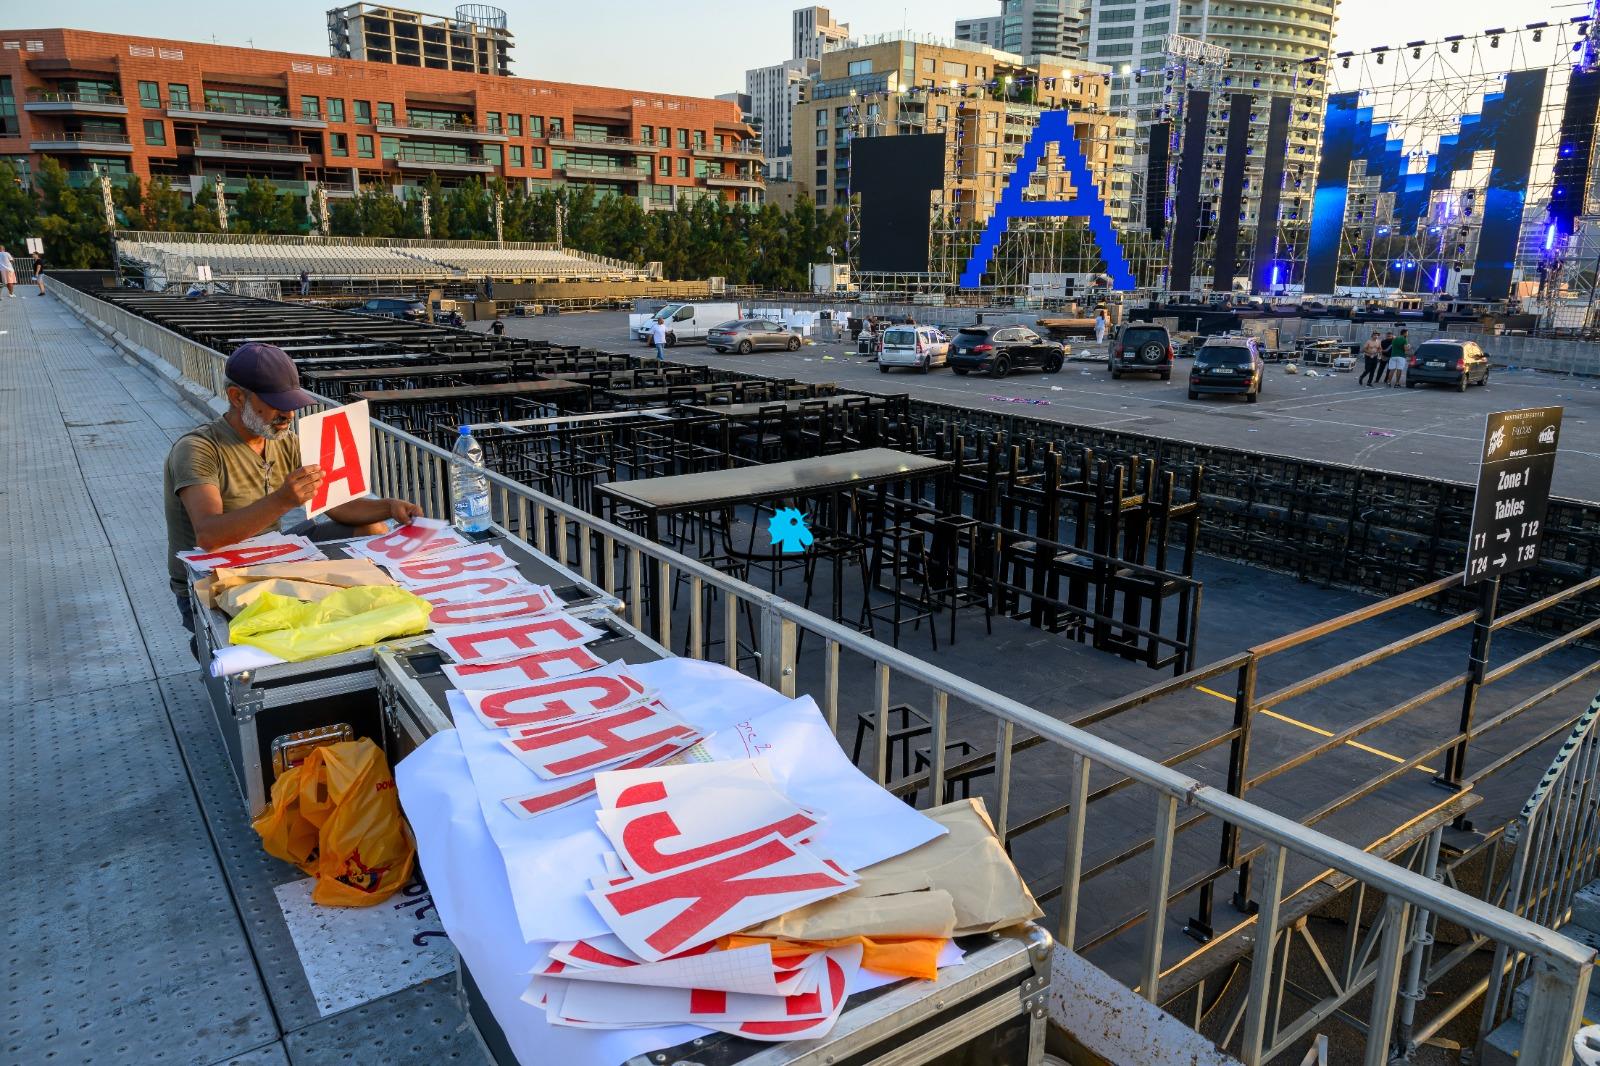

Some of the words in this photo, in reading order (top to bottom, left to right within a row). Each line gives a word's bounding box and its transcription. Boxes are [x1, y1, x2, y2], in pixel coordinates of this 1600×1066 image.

[960, 110, 1135, 289] A
[311, 411, 366, 512] A
[1497, 470, 1522, 491] Zone
[1524, 467, 1530, 486] 1
[1495, 498, 1525, 520] Tables
[400, 551, 506, 580] B
[429, 594, 547, 624] D
[447, 618, 584, 660] E
[454, 646, 601, 681] F
[480, 676, 631, 728] G
[512, 705, 694, 775] H
[623, 810, 818, 875] J
[605, 839, 847, 955] K
